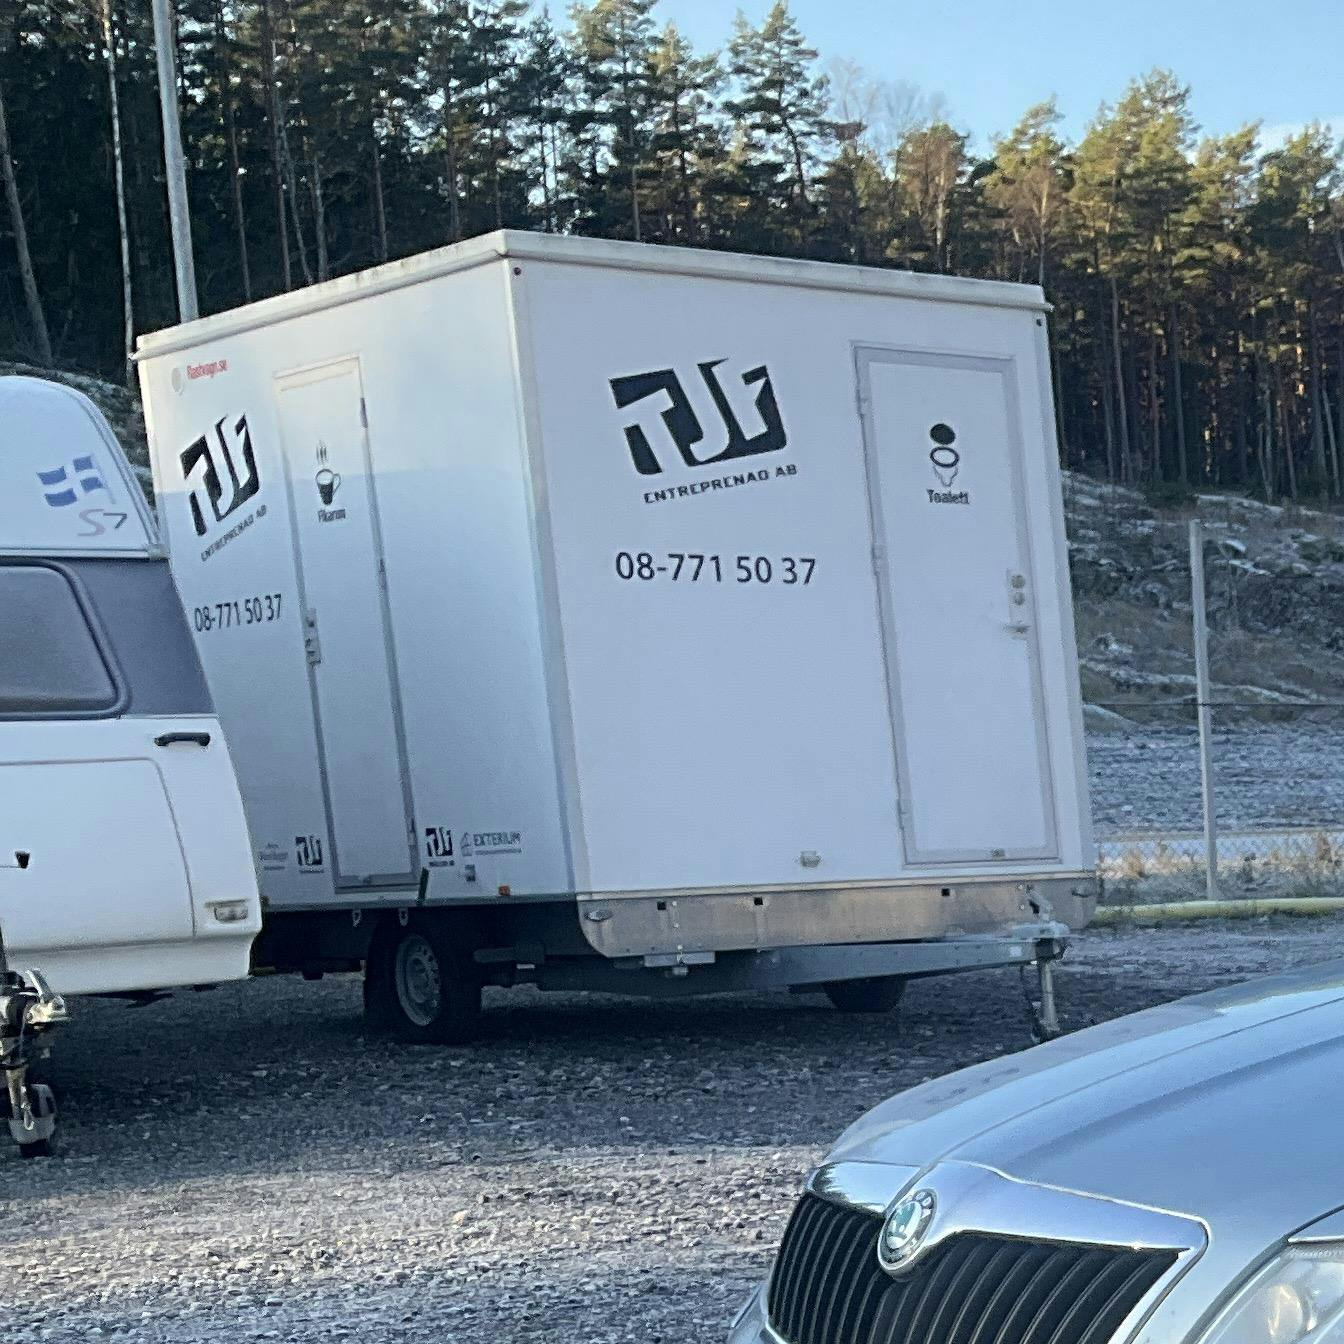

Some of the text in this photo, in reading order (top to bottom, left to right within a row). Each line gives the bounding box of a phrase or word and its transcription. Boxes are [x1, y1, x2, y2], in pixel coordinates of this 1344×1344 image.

[642, 463, 798, 504] ENTREPRENAD AB
[615, 551, 816, 586] 08-771 50 37
[193, 593, 282, 633] 08-771 50 37
